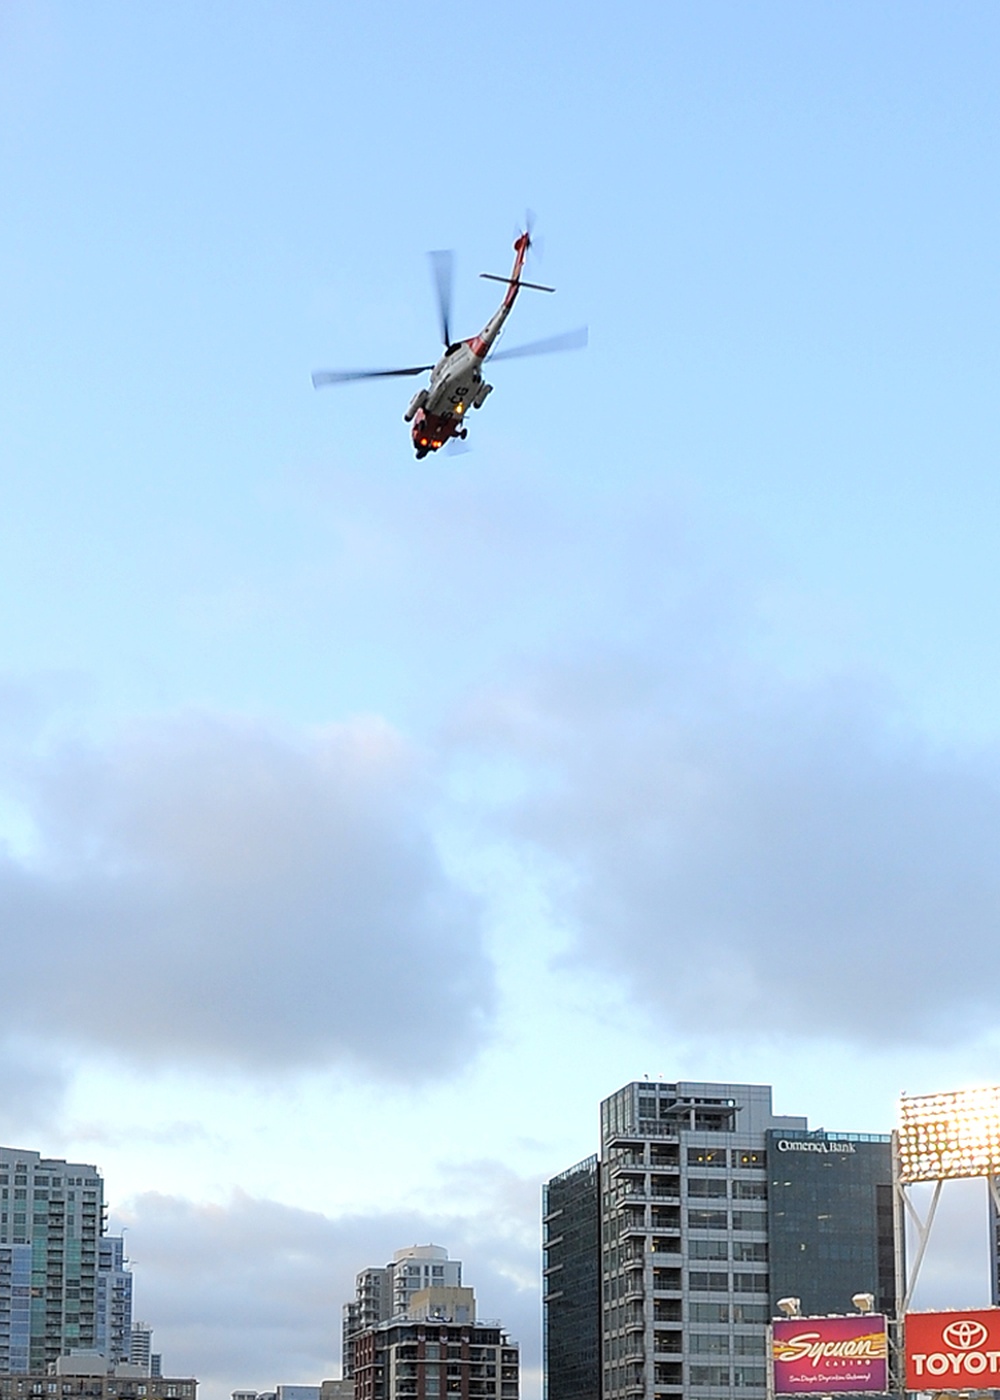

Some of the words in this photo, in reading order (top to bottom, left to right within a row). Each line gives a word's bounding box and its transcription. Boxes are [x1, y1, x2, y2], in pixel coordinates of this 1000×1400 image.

[829, 1142, 856, 1153] Bank
[779, 1333, 880, 1367] Sycuan
[826, 1359, 871, 1367] CASINO
[912, 1351, 1000, 1376] TOYOT
